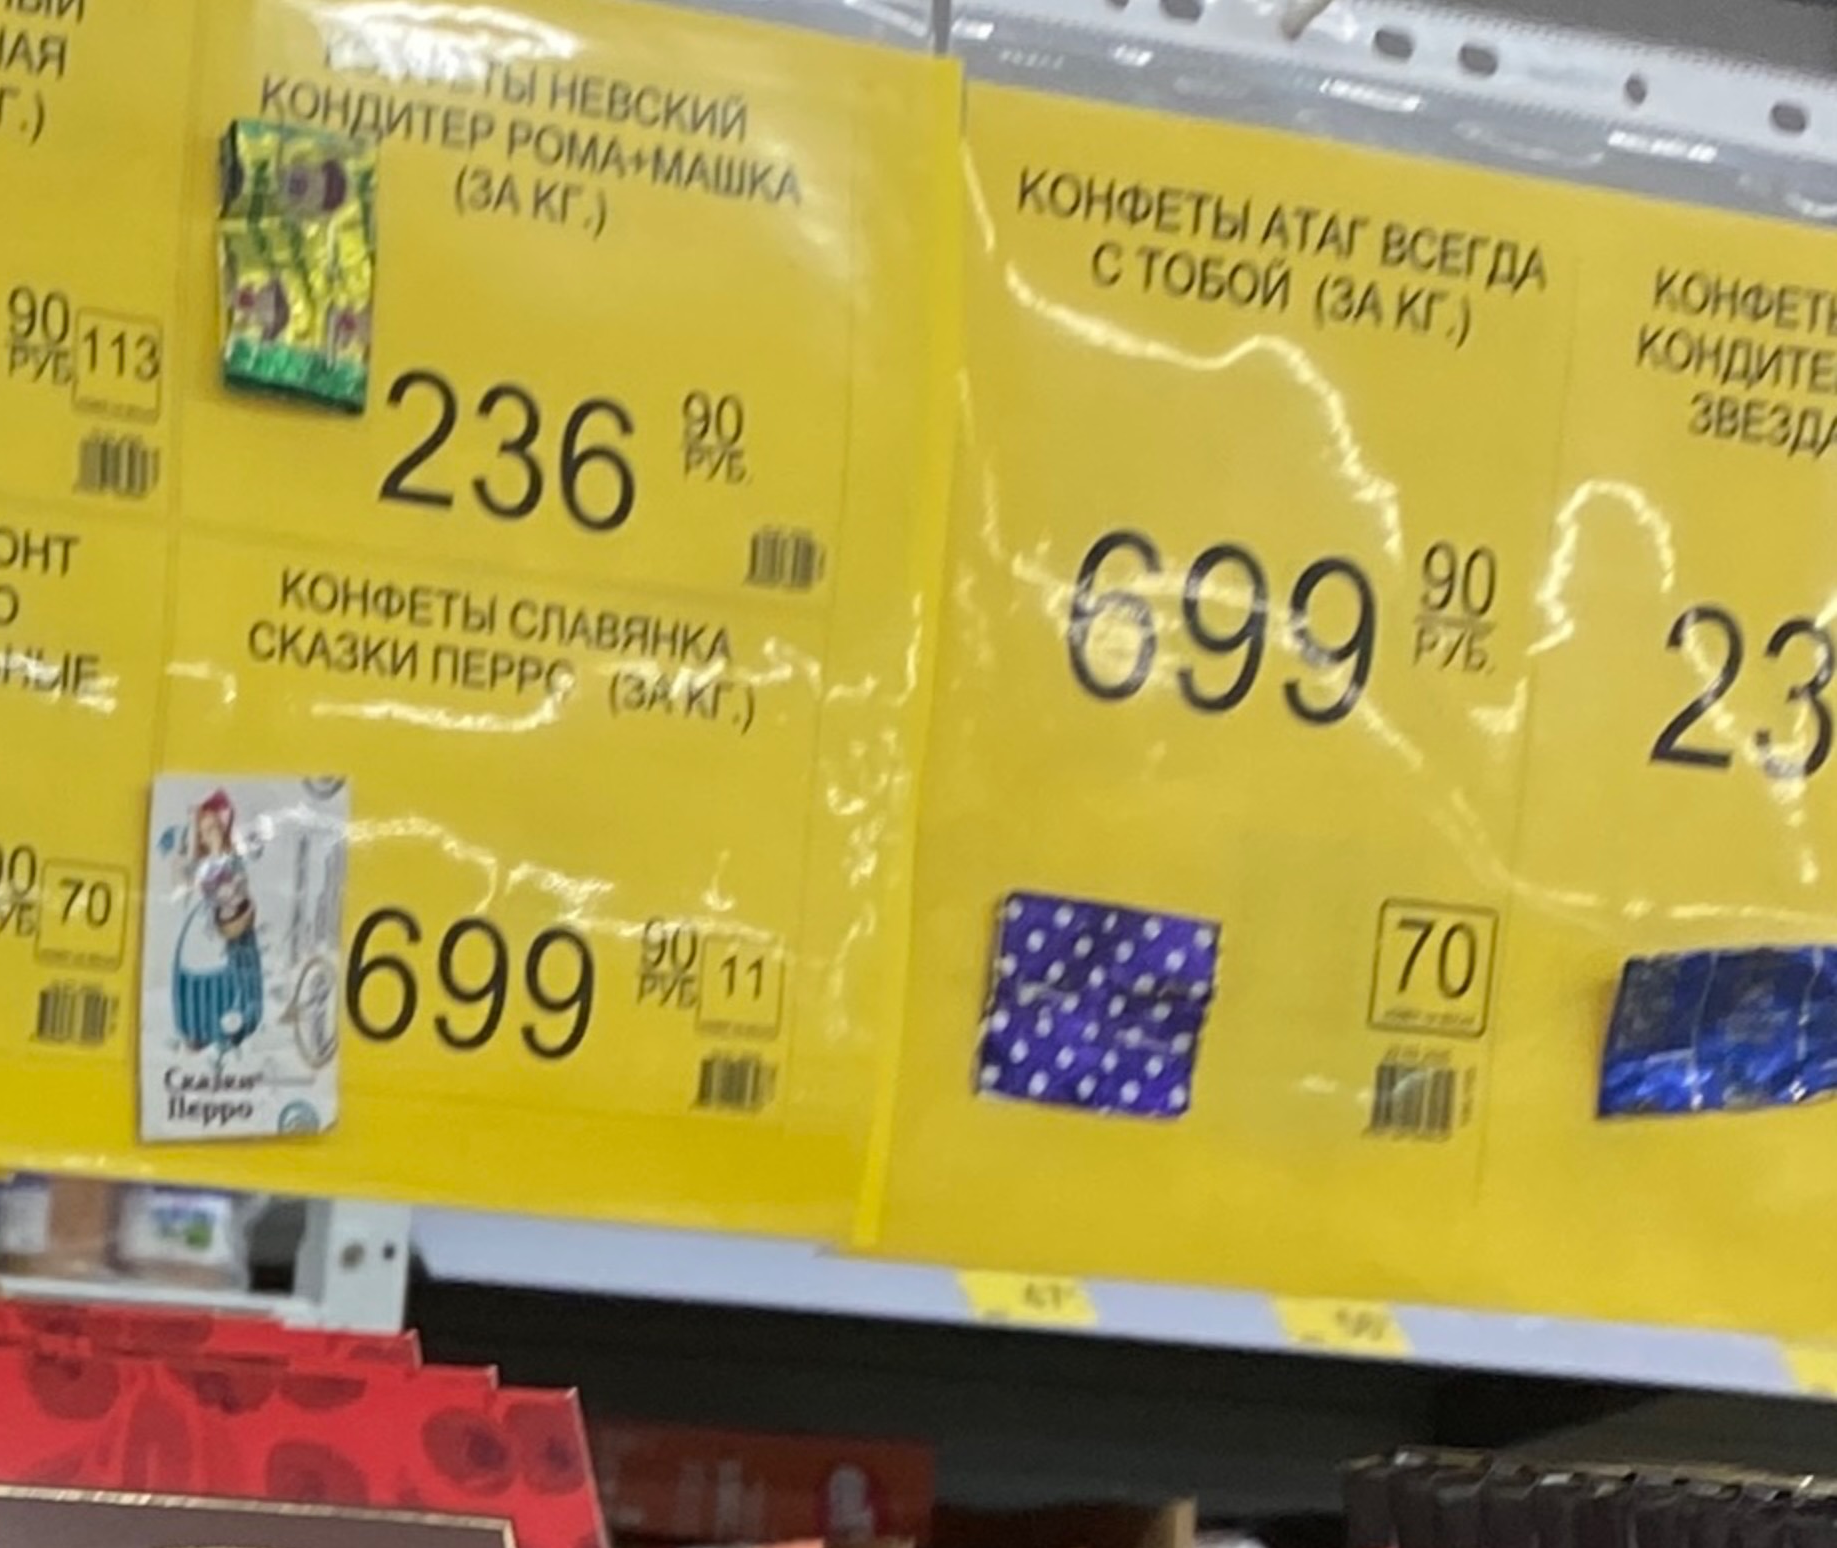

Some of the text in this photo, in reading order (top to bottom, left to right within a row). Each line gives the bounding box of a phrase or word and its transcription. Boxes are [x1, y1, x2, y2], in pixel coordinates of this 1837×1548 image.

[260, 74, 803, 205] КОНДИТЕР РОМА+МАШКА
[549, 74, 751, 142] НЕВСКИЙ
[453, 164, 608, 238] (ЗА КГ.)
[1017, 168, 1548, 293] КОНФЕТЫ АТАГ ВСЕГДА
[8, 286, 72, 346] 90
[1090, 241, 1474, 350] С ТОБОЙ (ЗА КГ.)
[1654, 265, 1837, 338] КОНФЕТ
[81, 327, 161, 381] 113
[378, 368, 637, 534] 236
[682, 389, 745, 446] 90
[279, 568, 733, 664] КОНФЕТЫ СЛАВЯНКА
[1421, 541, 1498, 619] 90
[248, 618, 421, 678] СКАЗКИ
[430, 639, 577, 700] ПЕРРО
[1067, 528, 1378, 727] 699
[58, 876, 113, 928] 70
[345, 906, 597, 1062] 699
[642, 919, 698, 972] 90
[717, 954, 767, 1000] 11
[1393, 920, 1480, 1002] 70
